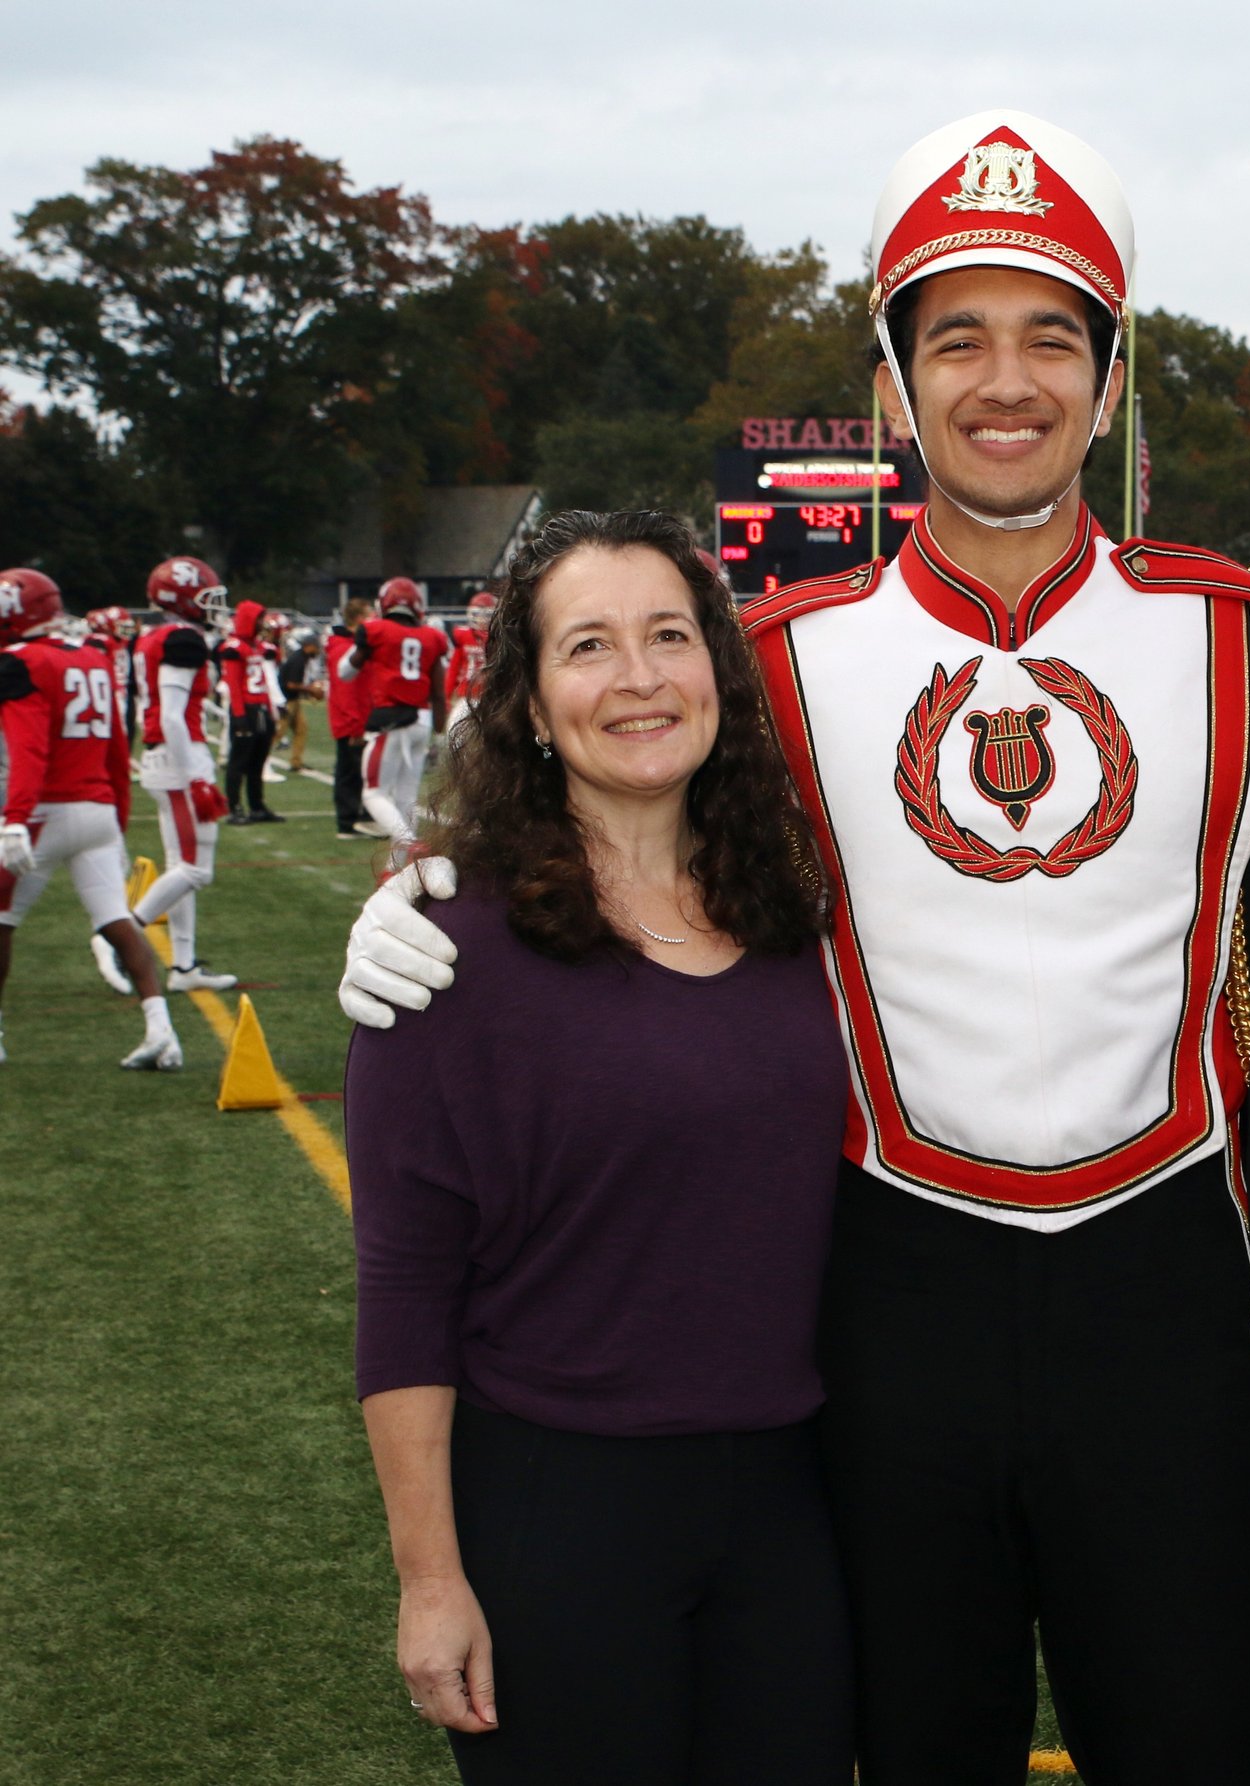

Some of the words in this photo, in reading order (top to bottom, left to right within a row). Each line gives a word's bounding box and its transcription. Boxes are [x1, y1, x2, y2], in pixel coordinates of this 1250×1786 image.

[747, 521, 763, 544] 0
[800, 505, 860, 528] 43:27
[401, 637, 421, 680] 8
[61, 667, 112, 739] 29
